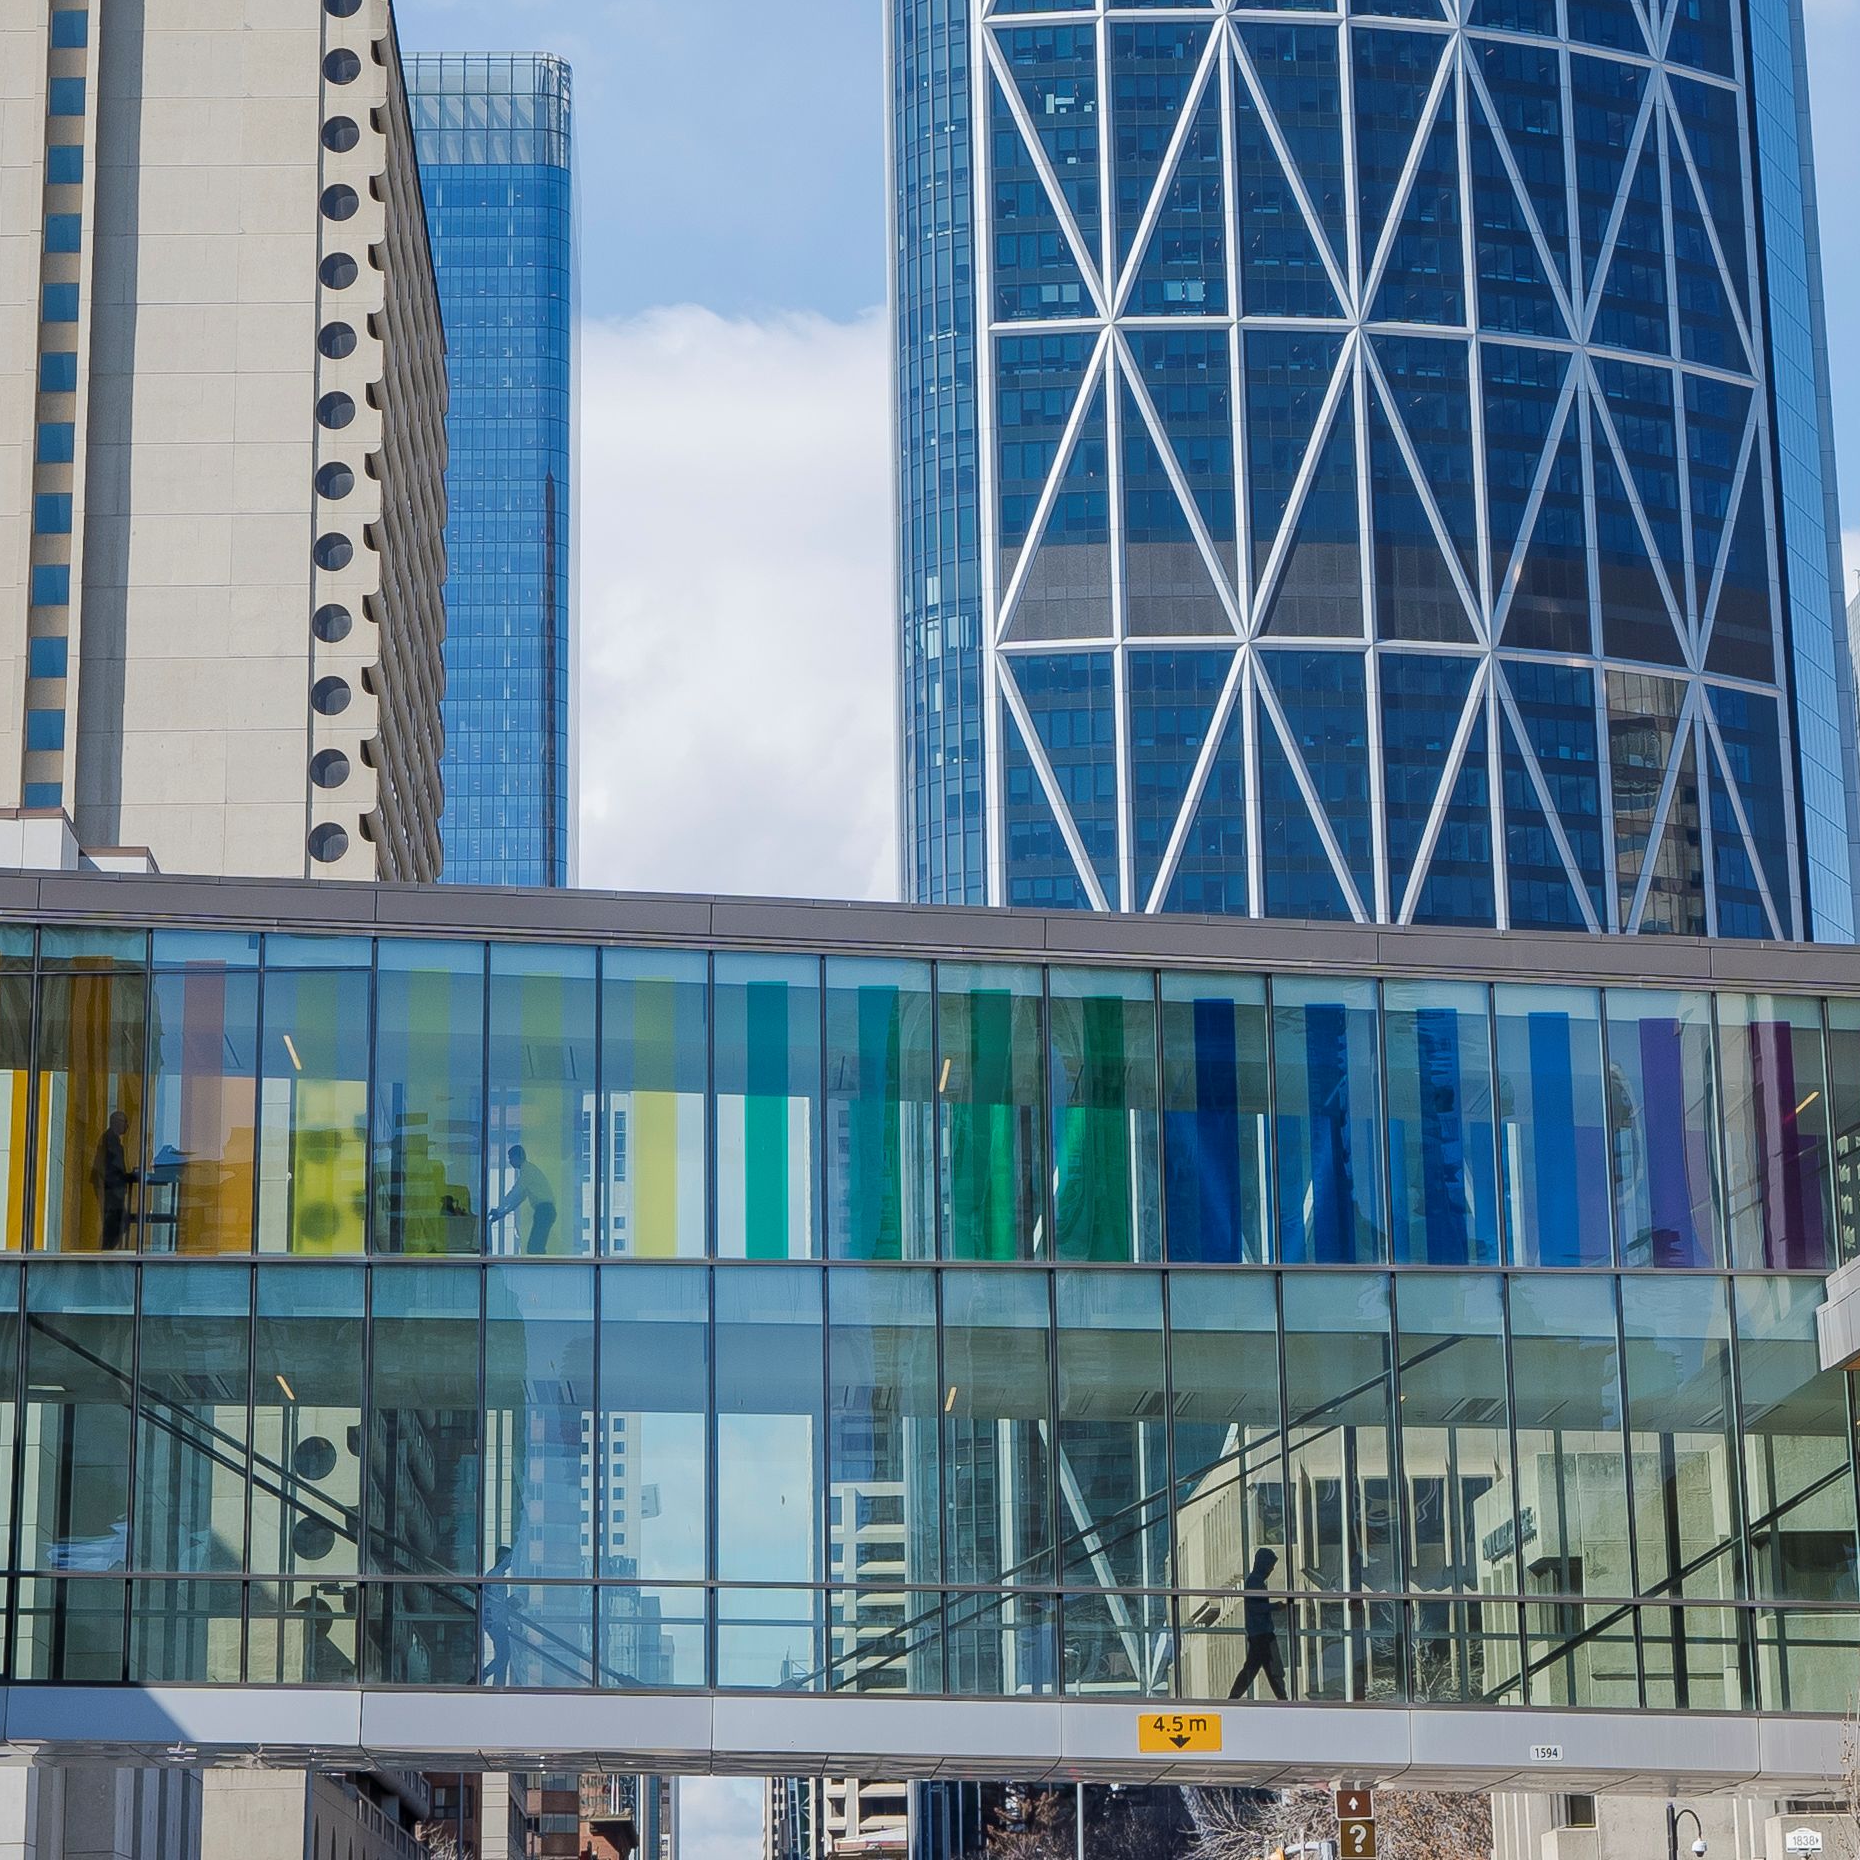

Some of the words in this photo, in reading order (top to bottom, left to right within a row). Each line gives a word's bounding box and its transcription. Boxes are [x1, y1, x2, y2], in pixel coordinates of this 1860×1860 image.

[1153, 1716, 1183, 1732] 4.5
[1189, 1718, 1207, 1731] m
[1535, 1748, 1558, 1758] 1594
[1793, 1836, 1815, 1846] 1838
